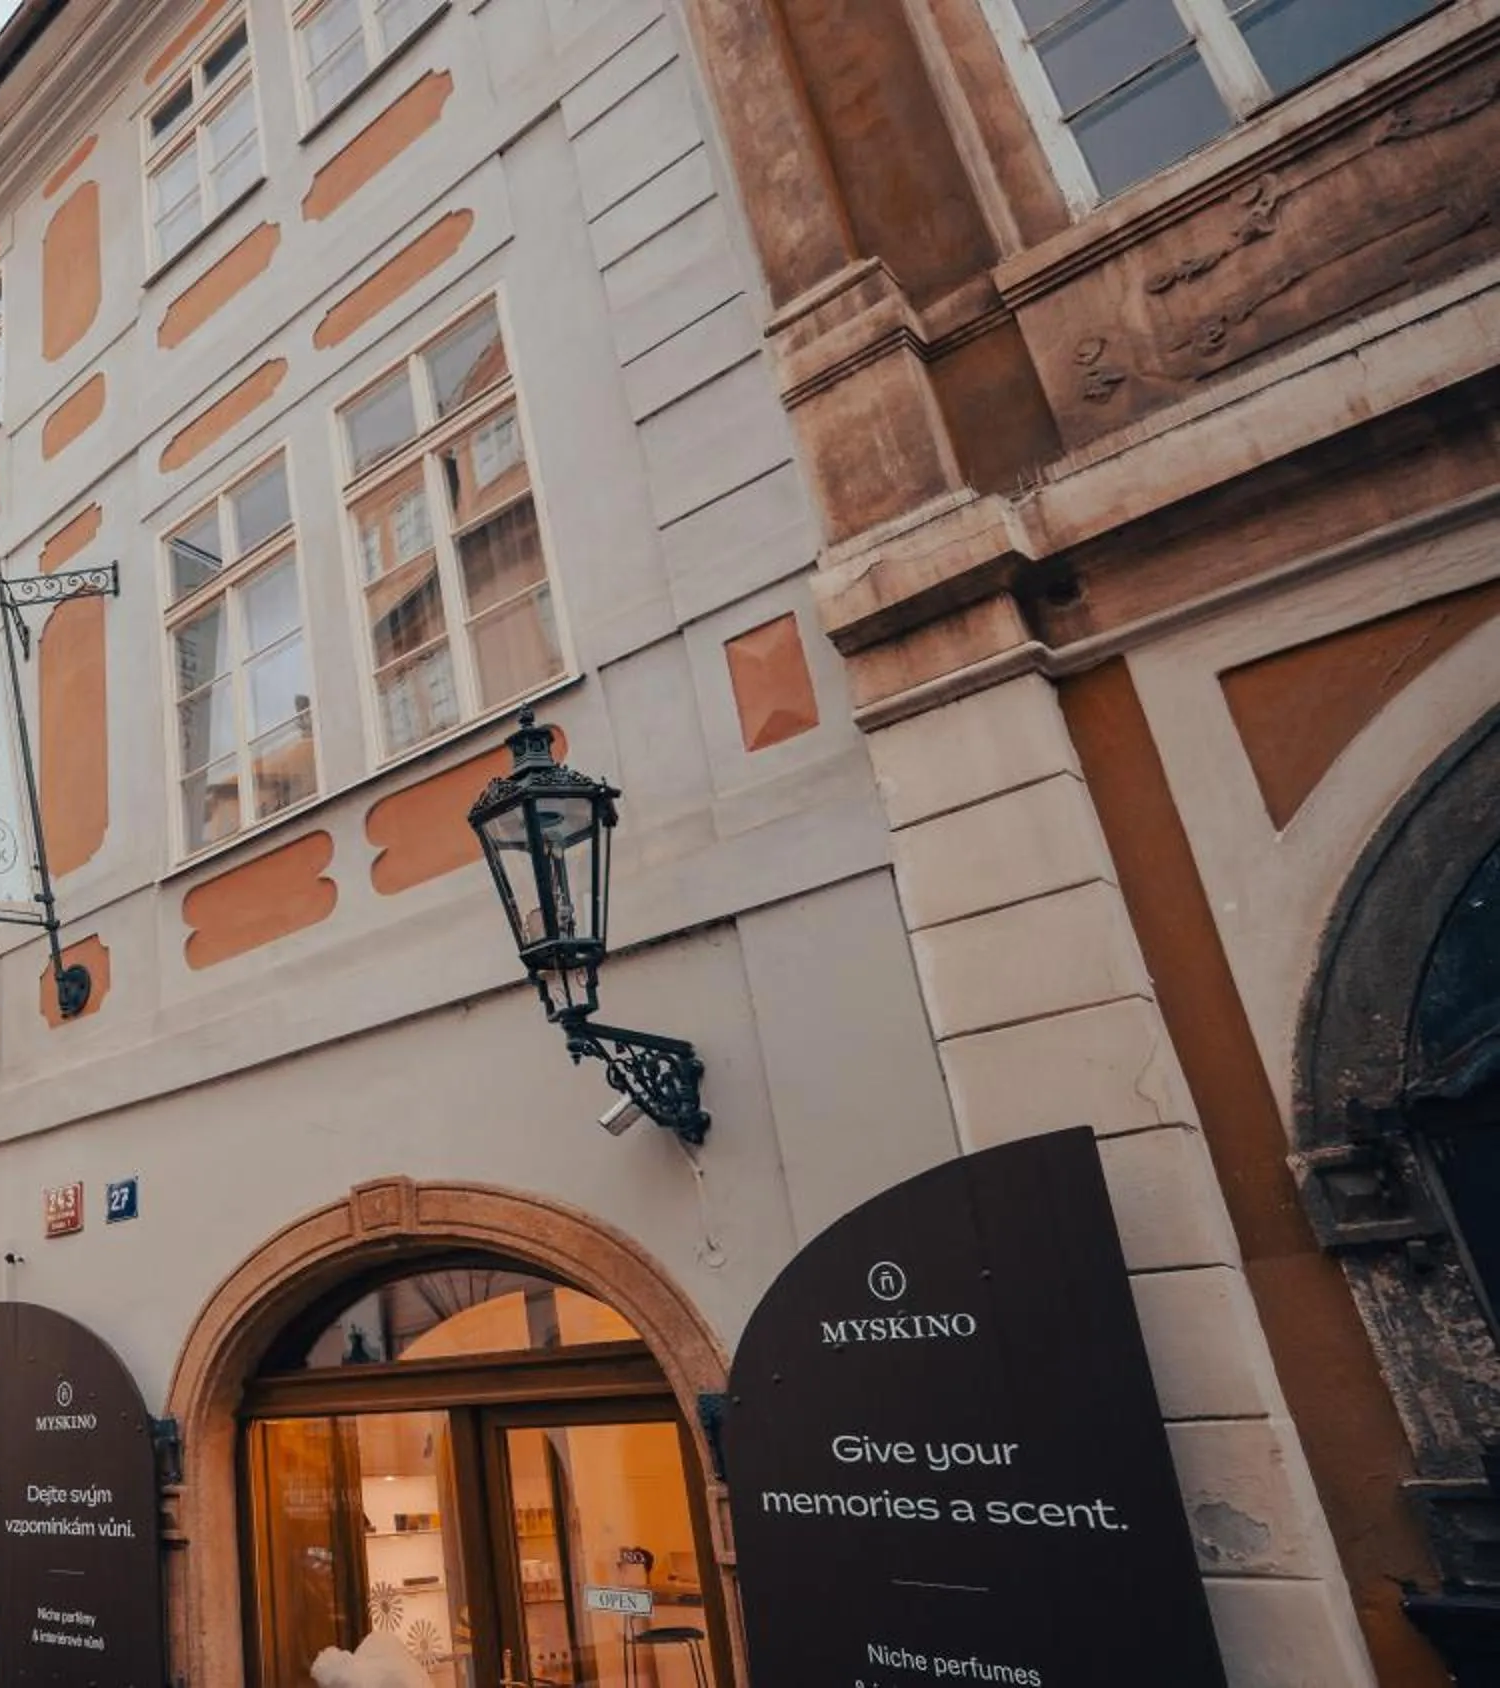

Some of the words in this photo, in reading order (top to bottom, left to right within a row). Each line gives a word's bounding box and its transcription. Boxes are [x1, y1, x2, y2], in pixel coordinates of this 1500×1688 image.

[49, 1188, 75, 1212] 243
[110, 1187, 130, 1211] 27
[820, 1312, 977, 1344] MYSKINO
[35, 1414, 97, 1431] MYSKINO
[832, 1435, 917, 1464] Give
[925, 1442, 1019, 1472] your
[26, 1484, 68, 1507] Dejte
[70, 1483, 113, 1507] svým
[762, 1489, 941, 1522] memories
[950, 1499, 976, 1523] a
[985, 1498, 1129, 1531] scent.
[98, 1516, 136, 1538] vůni.
[598, 1593, 637, 1609] OPEN
[867, 1643, 928, 1672] Niche
[933, 1656, 1042, 1687] perfumes
